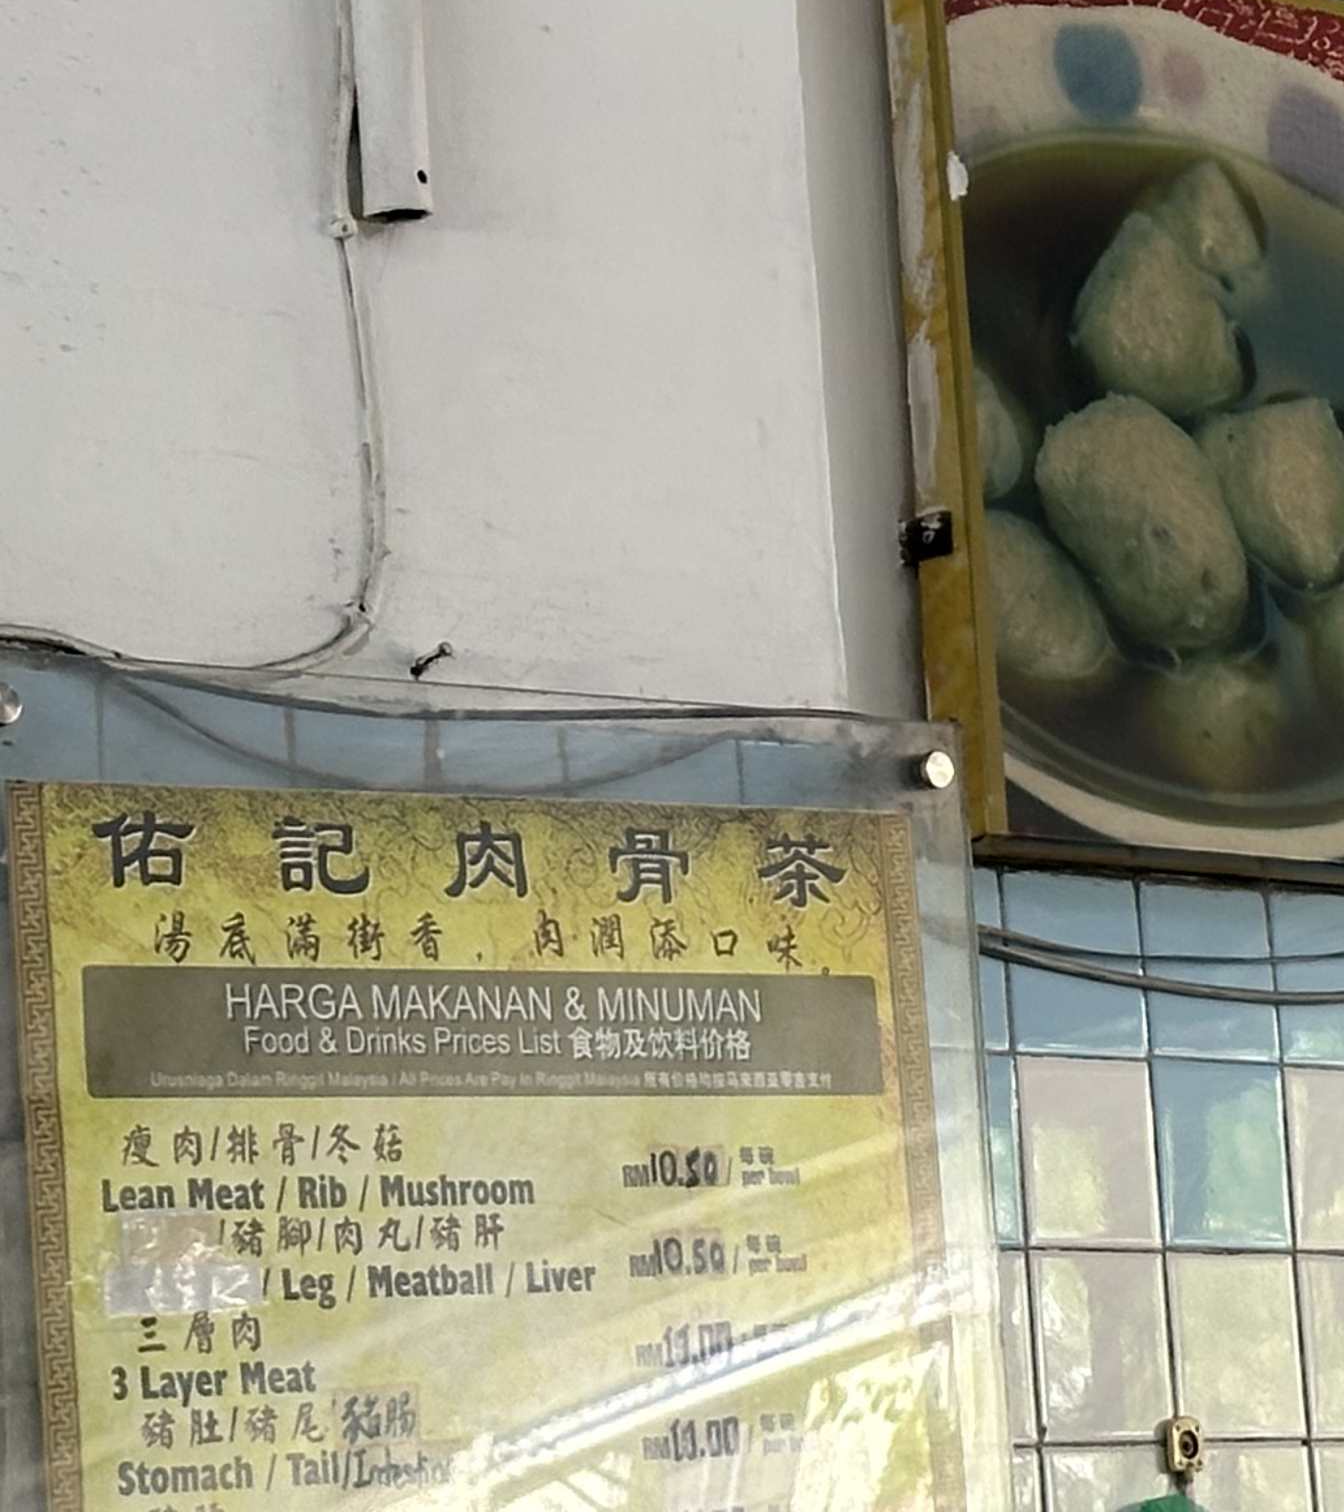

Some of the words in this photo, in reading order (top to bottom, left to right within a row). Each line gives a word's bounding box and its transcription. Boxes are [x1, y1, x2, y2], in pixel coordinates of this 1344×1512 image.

[92, 811, 847, 908] 佑記肉骨茶
[225, 982, 363, 1021] HARGA
[371, 984, 552, 1022] MAKANAN
[564, 985, 588, 1023] &
[597, 986, 762, 1024] MINUMAN
[244, 1026, 310, 1055] Food
[318, 1027, 338, 1055] &
[347, 1026, 427, 1055] Drinks
[434, 1027, 511, 1056] Prices
[519, 1028, 561, 1056] List
[568, 1028, 753, 1061] 食物及饮料价格
[101, 1178, 176, 1213] Lean
[188, 1176, 265, 1211] Meat
[298, 1175, 347, 1209] Rib
[380, 1174, 535, 1208] Mushroom
[282, 1268, 335, 1309] Leg
[367, 1261, 494, 1298] Meatball
[526, 1259, 597, 1293] Liver
[137, 1310, 262, 1353] 三層肉
[111, 1365, 129, 1401] 3
[140, 1364, 228, 1407] Layer
[239, 1360, 317, 1396] Meat
[118, 1450, 254, 1496] Stomach
